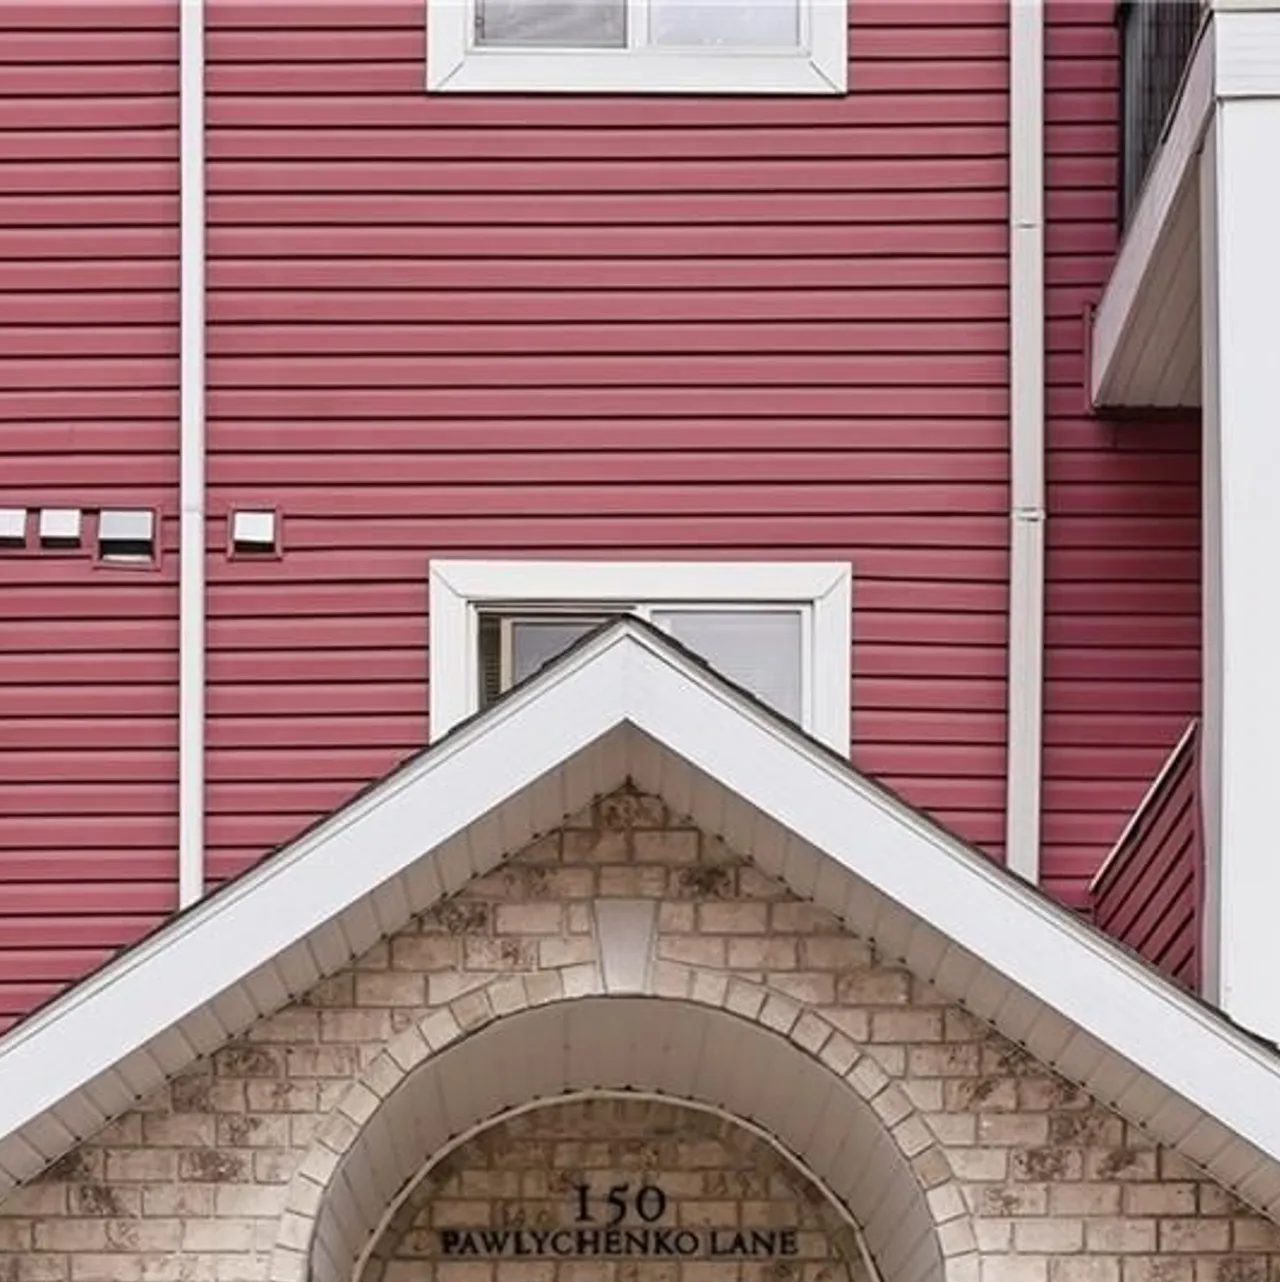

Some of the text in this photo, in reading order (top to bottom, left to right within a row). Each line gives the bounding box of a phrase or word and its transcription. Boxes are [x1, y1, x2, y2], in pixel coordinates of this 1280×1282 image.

[574, 1185, 666, 1222] 150
[441, 1230, 799, 1256] PAWLYCHENKO LANE
